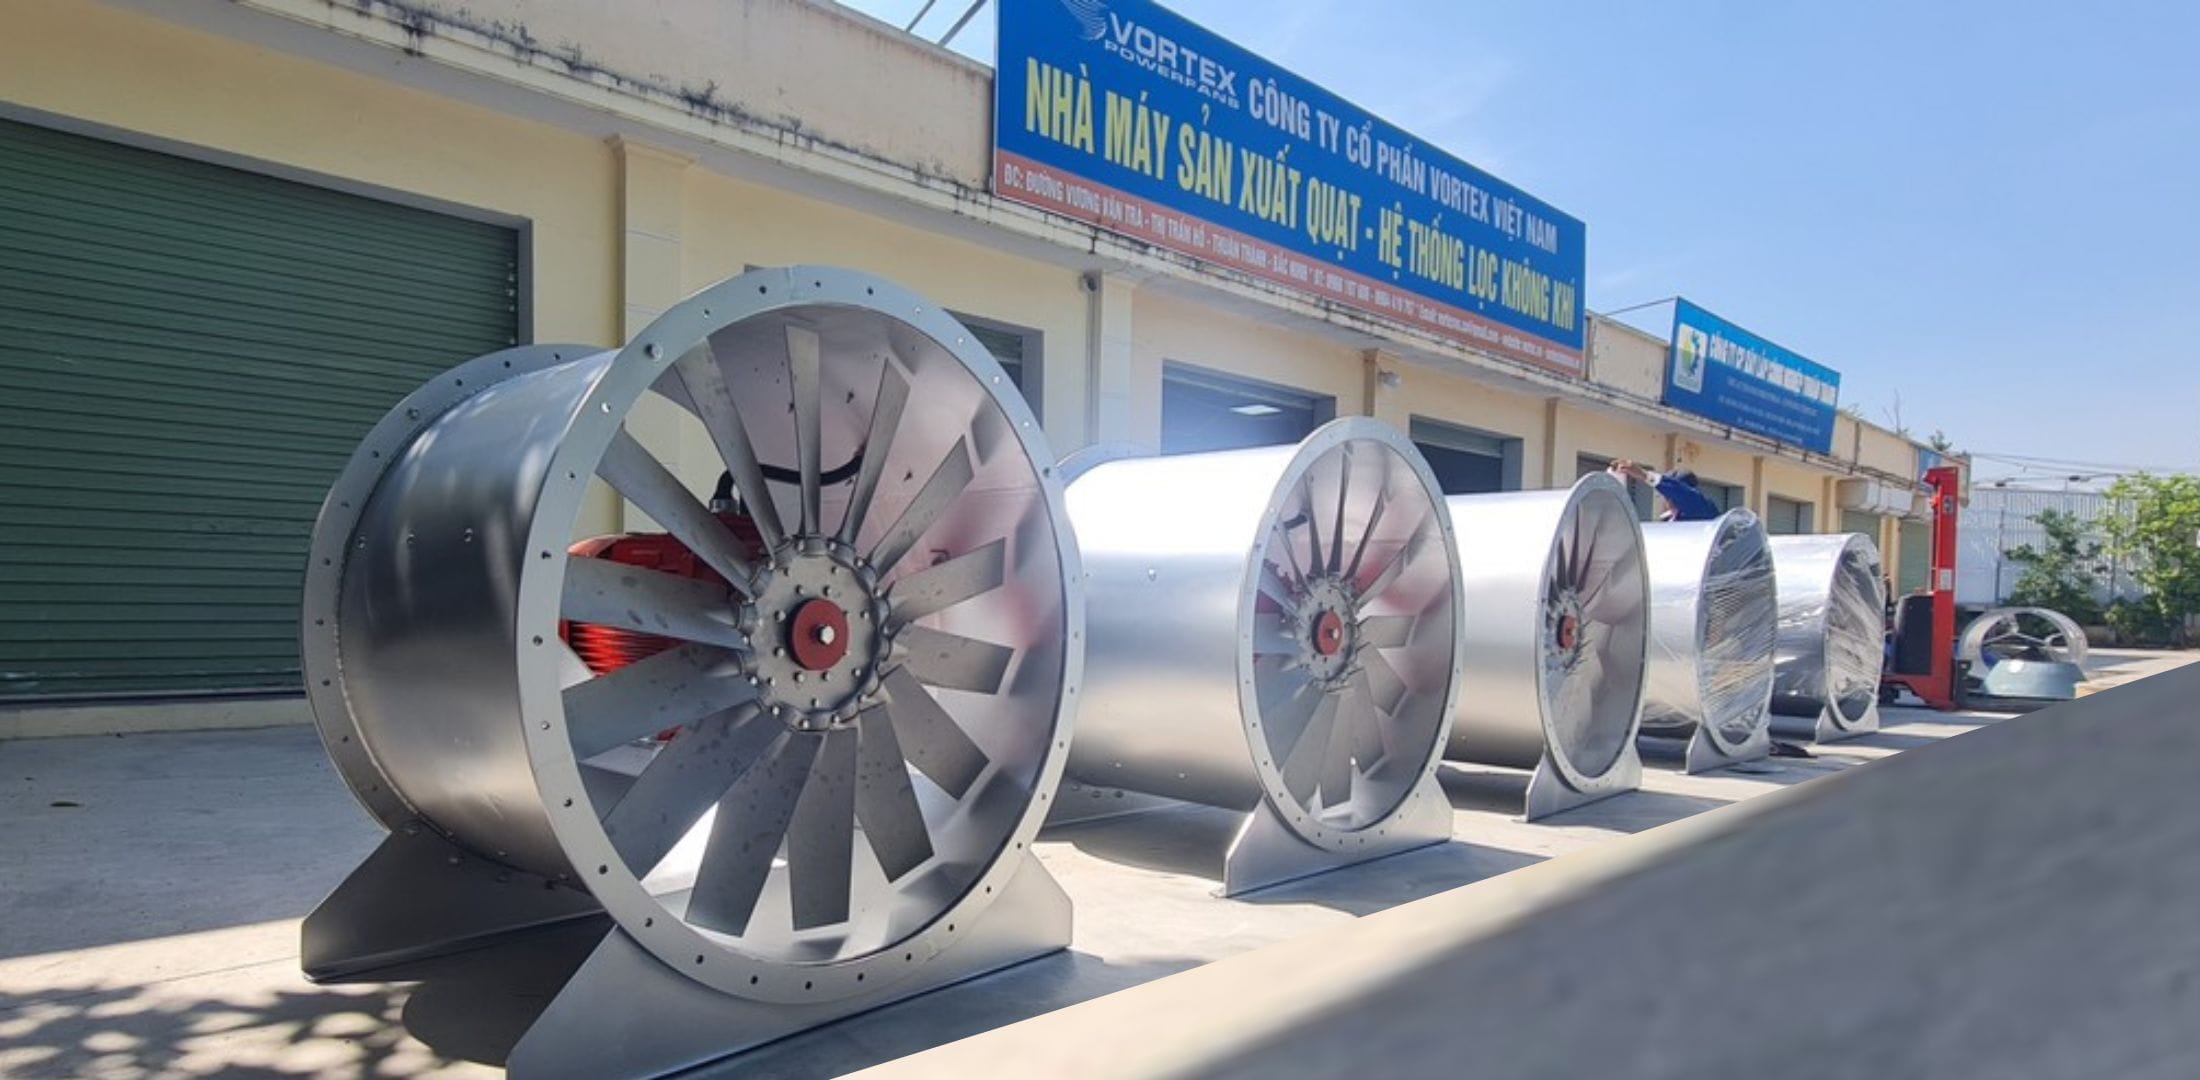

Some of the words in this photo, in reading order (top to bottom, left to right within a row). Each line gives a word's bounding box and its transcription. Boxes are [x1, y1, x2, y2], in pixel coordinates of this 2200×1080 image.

[1110, 12, 1237, 96] VORTEX
[1026, 56, 1095, 154] NHÀ
[1104, 91, 1170, 180] MÁY
[1177, 102, 1232, 205] SẢN
[1239, 144, 1301, 229] XUẤT
[1306, 177, 1361, 260] QUẠT
[1378, 201, 1404, 280] HỆ
[1408, 212, 1465, 291] THỐNG
[1468, 245, 1498, 310] LỌC
[1502, 257, 1549, 322] KHÔNG
[1552, 277, 1576, 331] KHÍ
[1249, 78, 1310, 141] CÔNG
[1316, 110, 1340, 154] TY
[1346, 120, 1373, 169] CỔ
[1429, 166, 1490, 225] VORTEX
[1493, 196, 1523, 241] VIỆT
[1525, 213, 1557, 255] NAM
